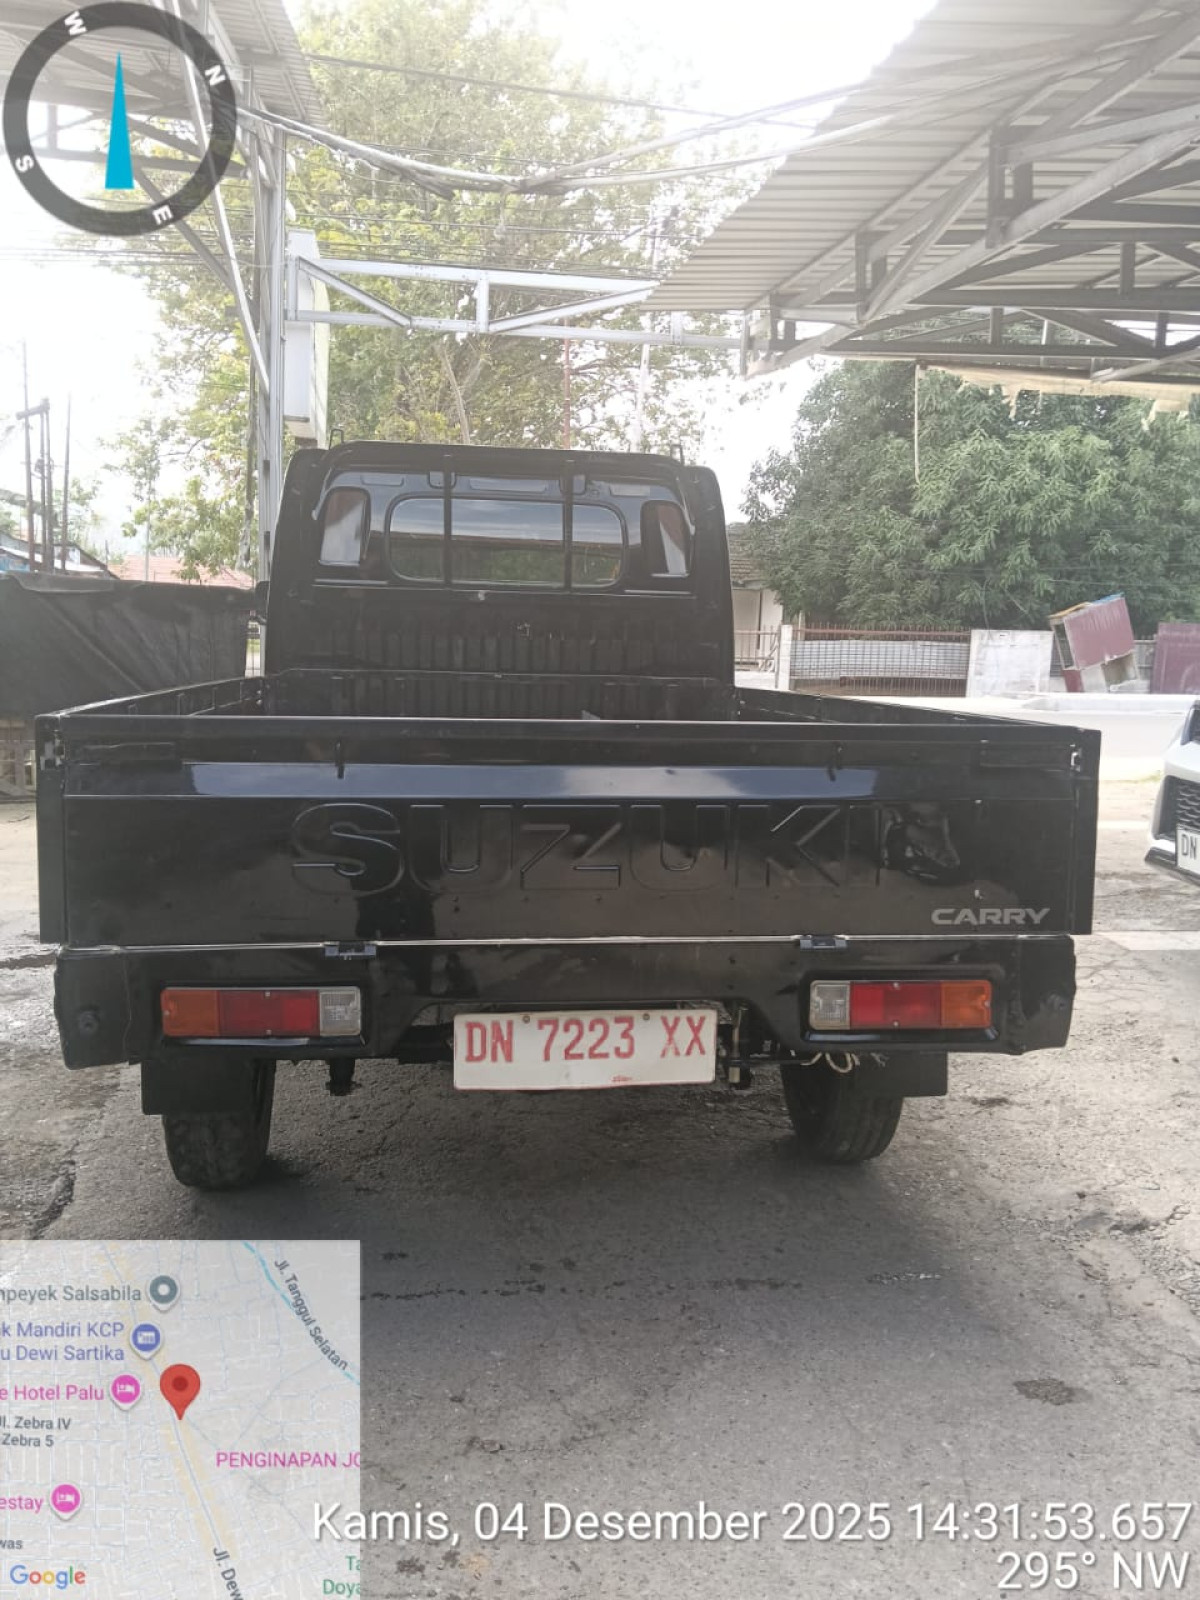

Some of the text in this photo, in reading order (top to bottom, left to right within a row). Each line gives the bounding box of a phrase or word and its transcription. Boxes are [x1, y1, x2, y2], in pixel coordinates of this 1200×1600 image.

[291, 803, 881, 893] SUZUKI
[1182, 834, 1197, 860] DN
[931, 908, 1050, 925] CARRY
[465, 1015, 706, 1063] DN 7223 XX
